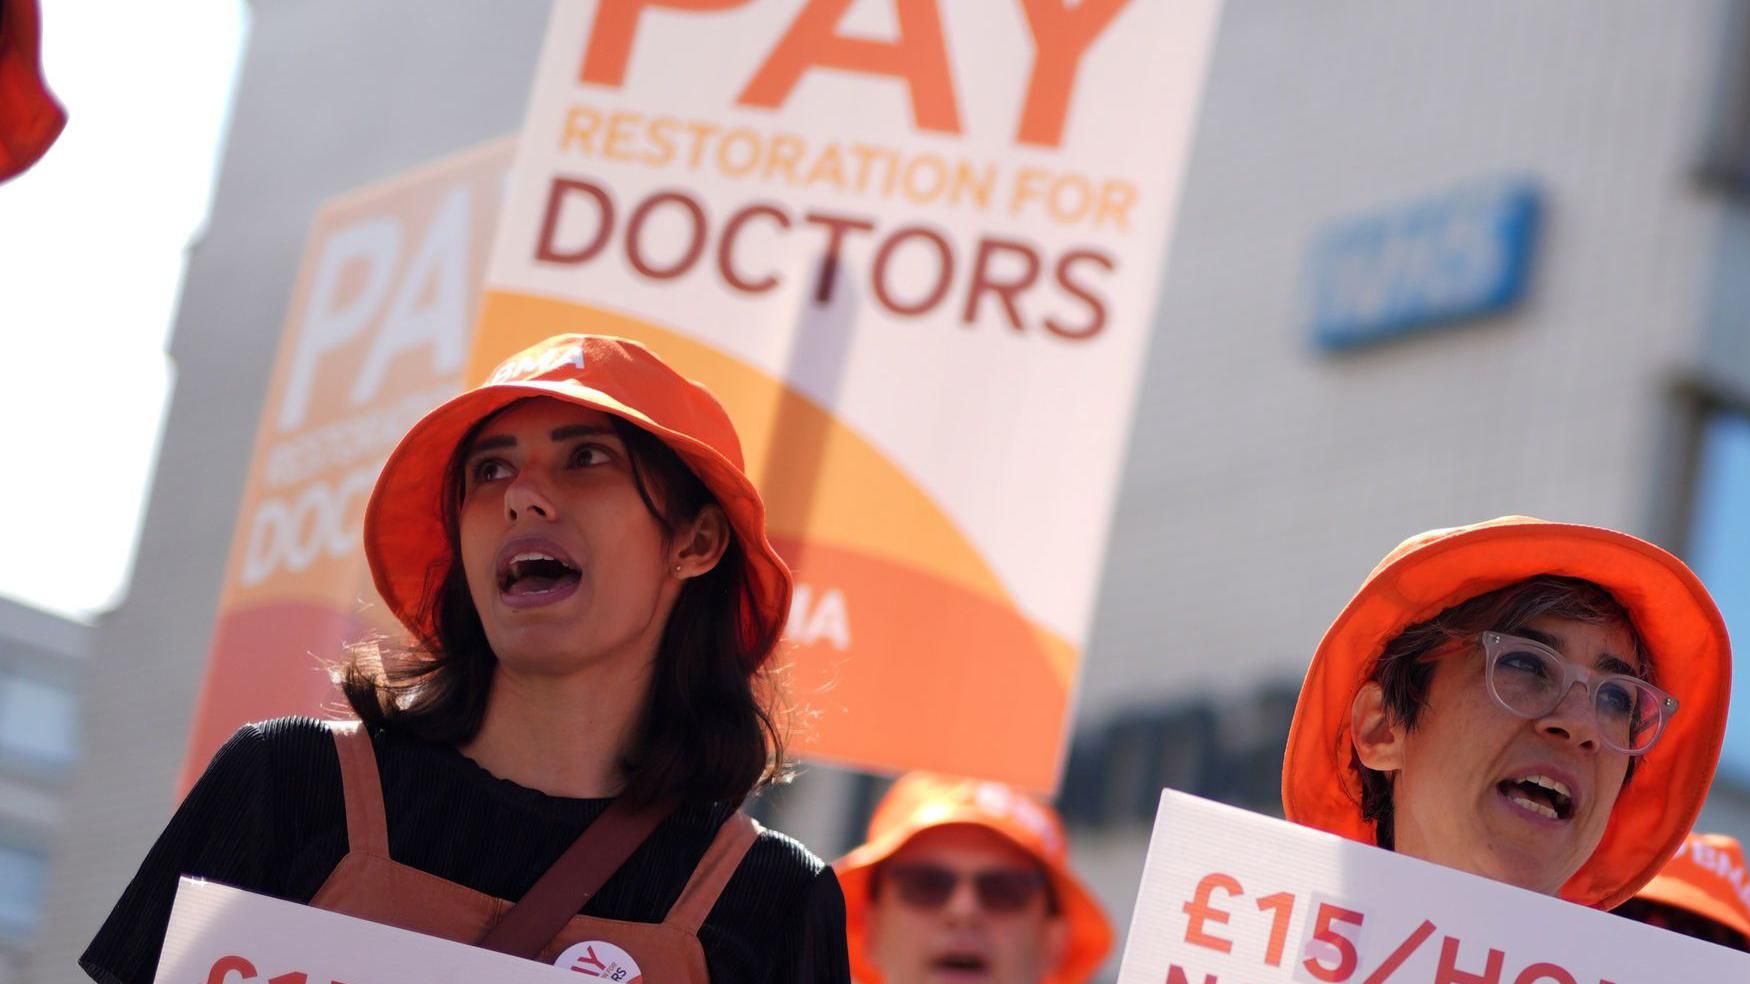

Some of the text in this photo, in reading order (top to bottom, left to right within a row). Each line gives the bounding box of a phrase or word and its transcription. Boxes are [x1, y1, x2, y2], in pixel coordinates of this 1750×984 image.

[560, 107, 1140, 233] RESTORATION FOR
[276, 166, 512, 432] PA
[534, 177, 1122, 344] DOCTORS
